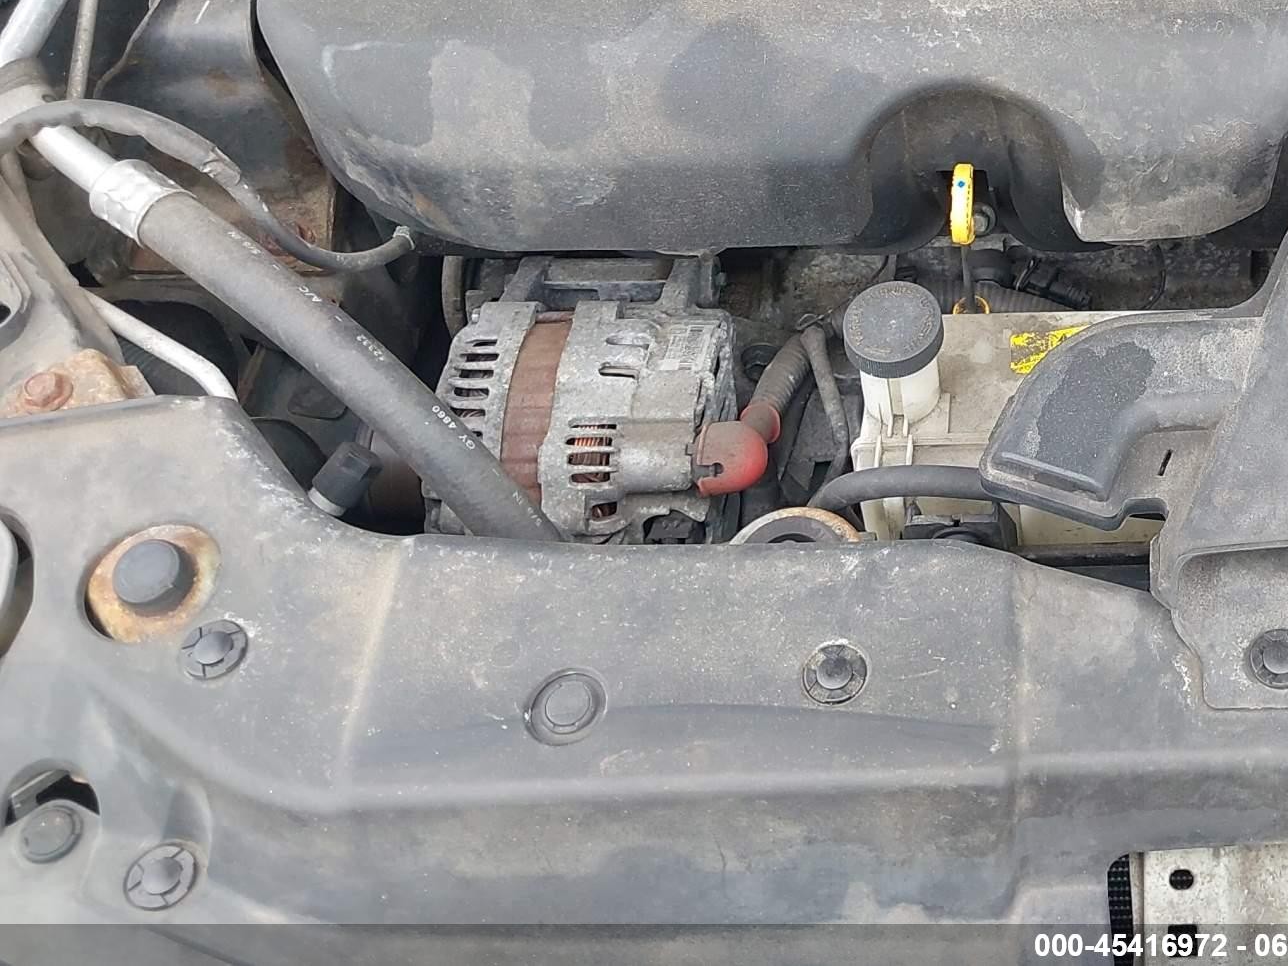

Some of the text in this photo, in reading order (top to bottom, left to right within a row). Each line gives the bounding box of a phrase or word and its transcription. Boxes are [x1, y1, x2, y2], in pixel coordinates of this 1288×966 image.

[297, 285, 322, 302] A/C
[431, 404, 458, 430] 4860
[458, 434, 477, 451] GY
